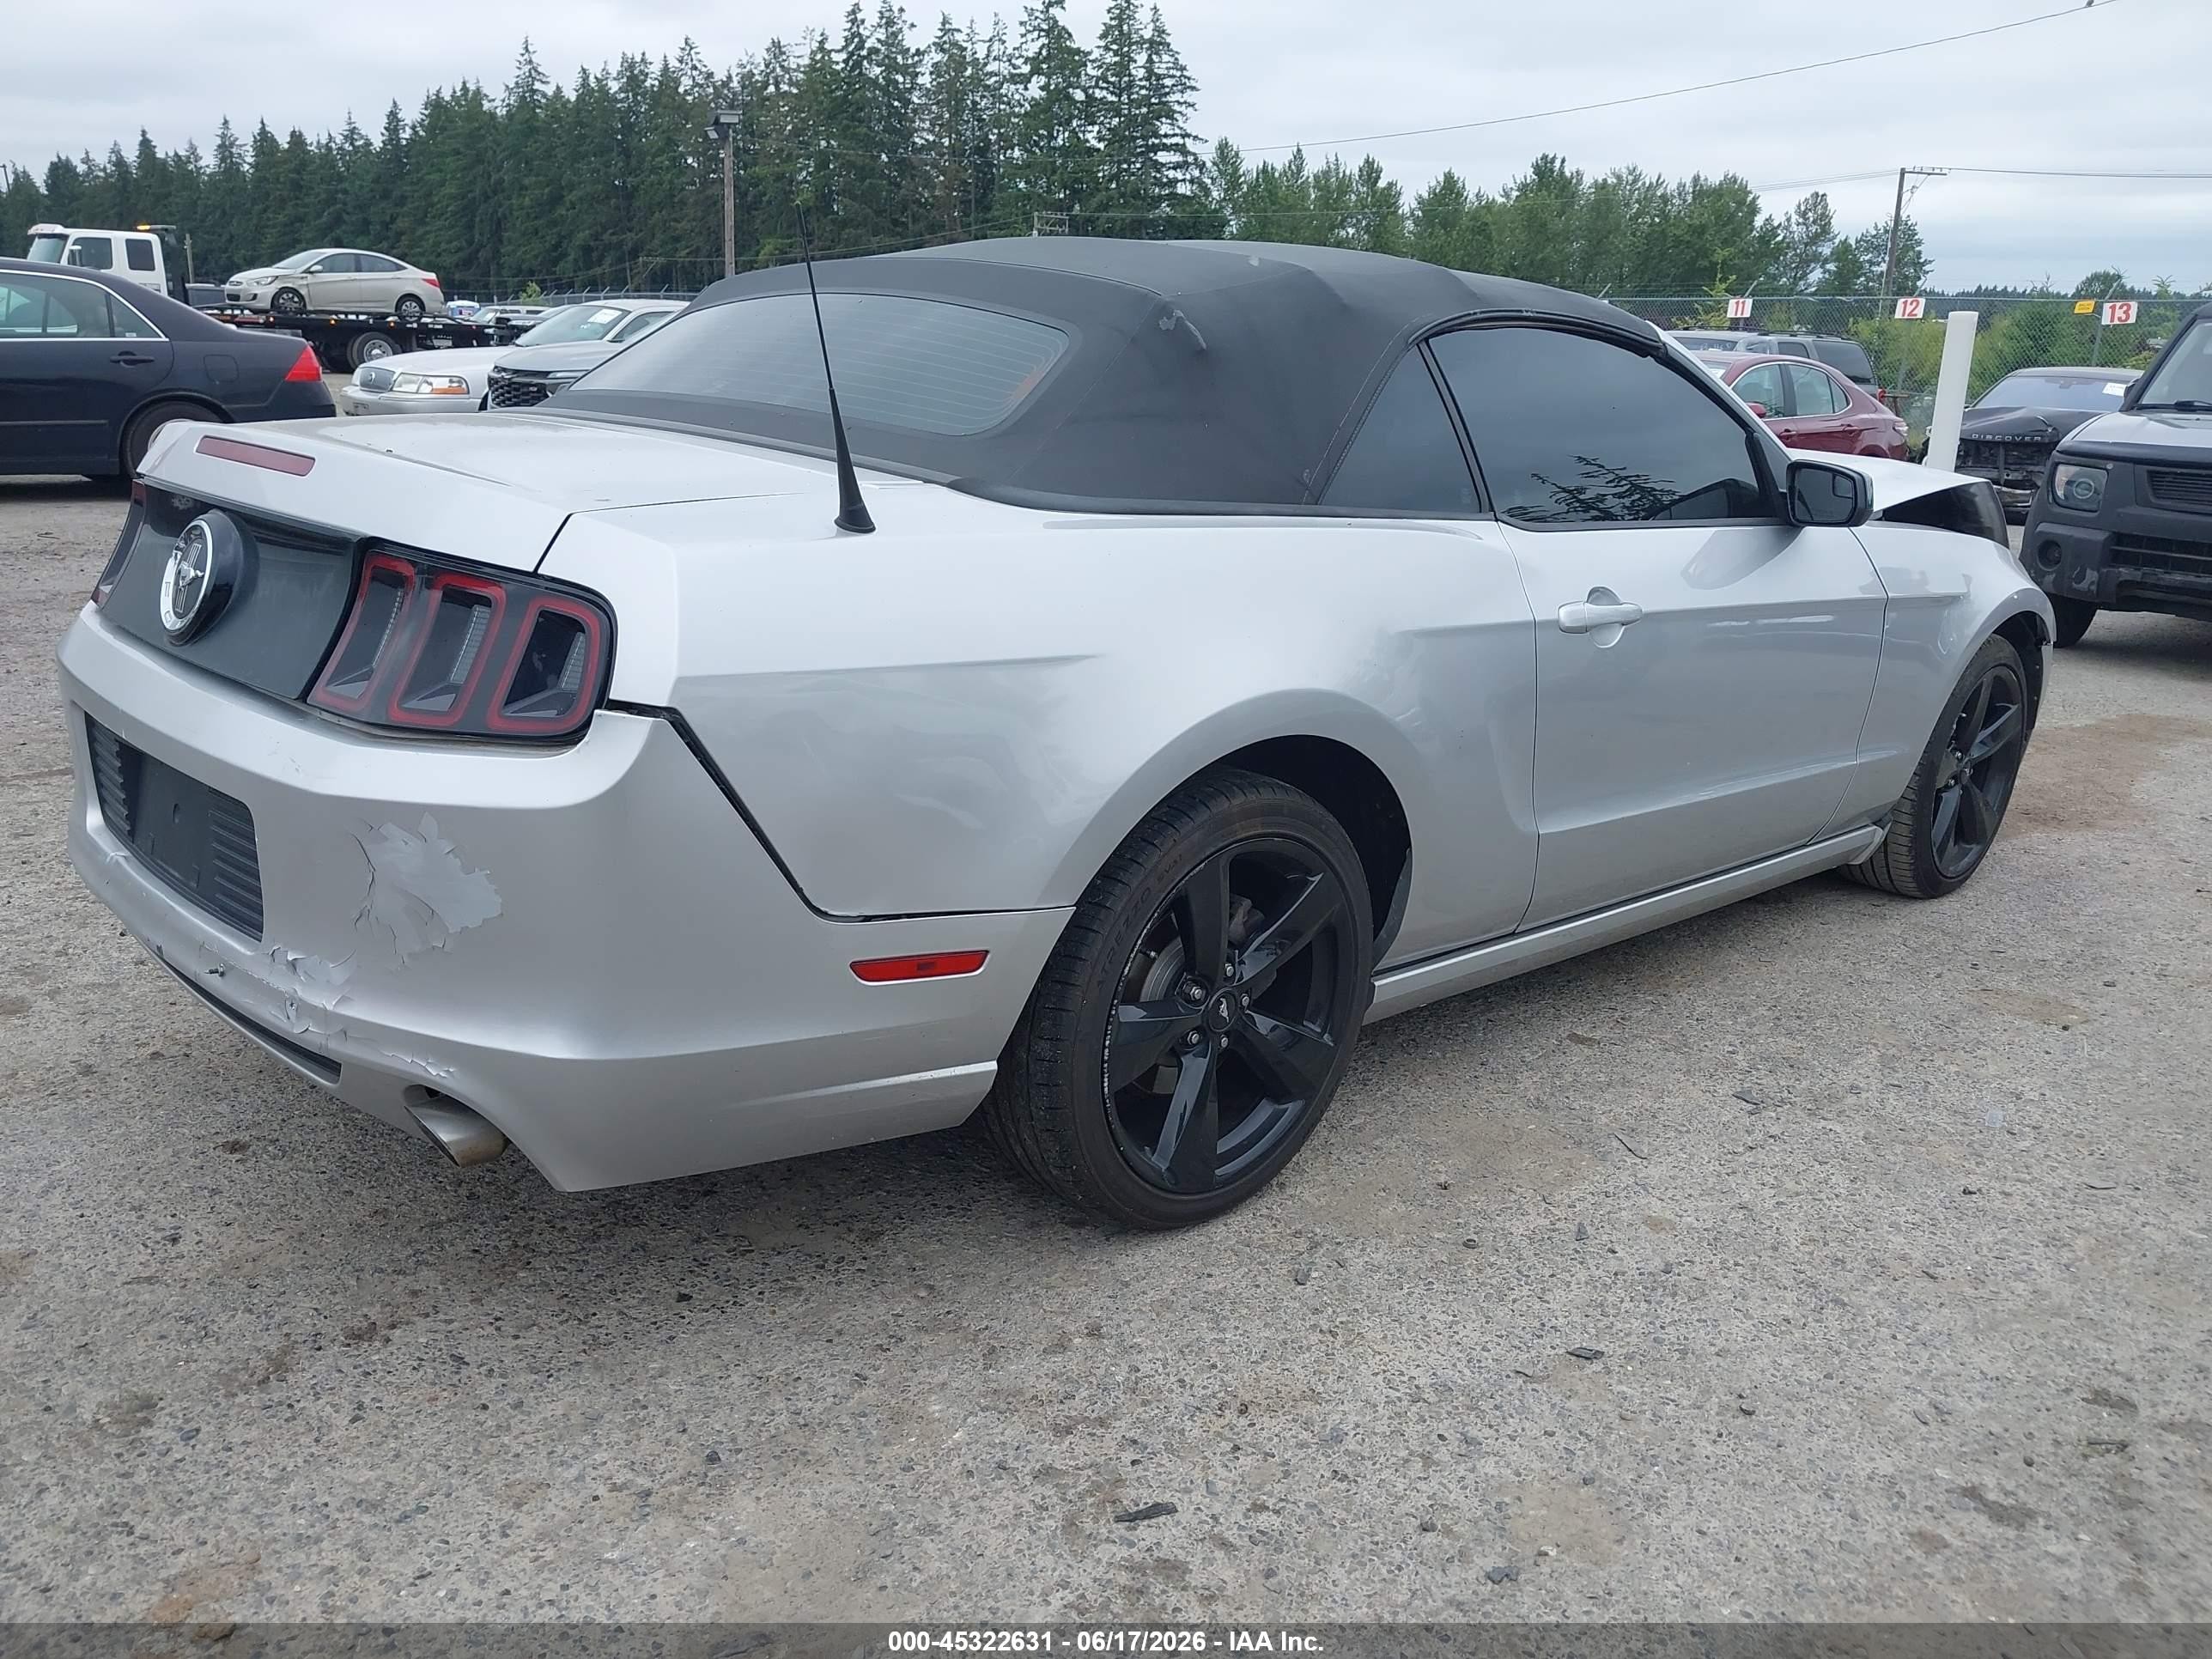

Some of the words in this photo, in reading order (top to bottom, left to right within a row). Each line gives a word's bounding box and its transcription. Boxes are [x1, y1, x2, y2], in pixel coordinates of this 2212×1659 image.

[1734, 300, 1747, 317] 11
[1901, 299, 1920, 317] 12
[2108, 302, 2132, 324] 13
[1972, 433, 2042, 441] DISCOVER
